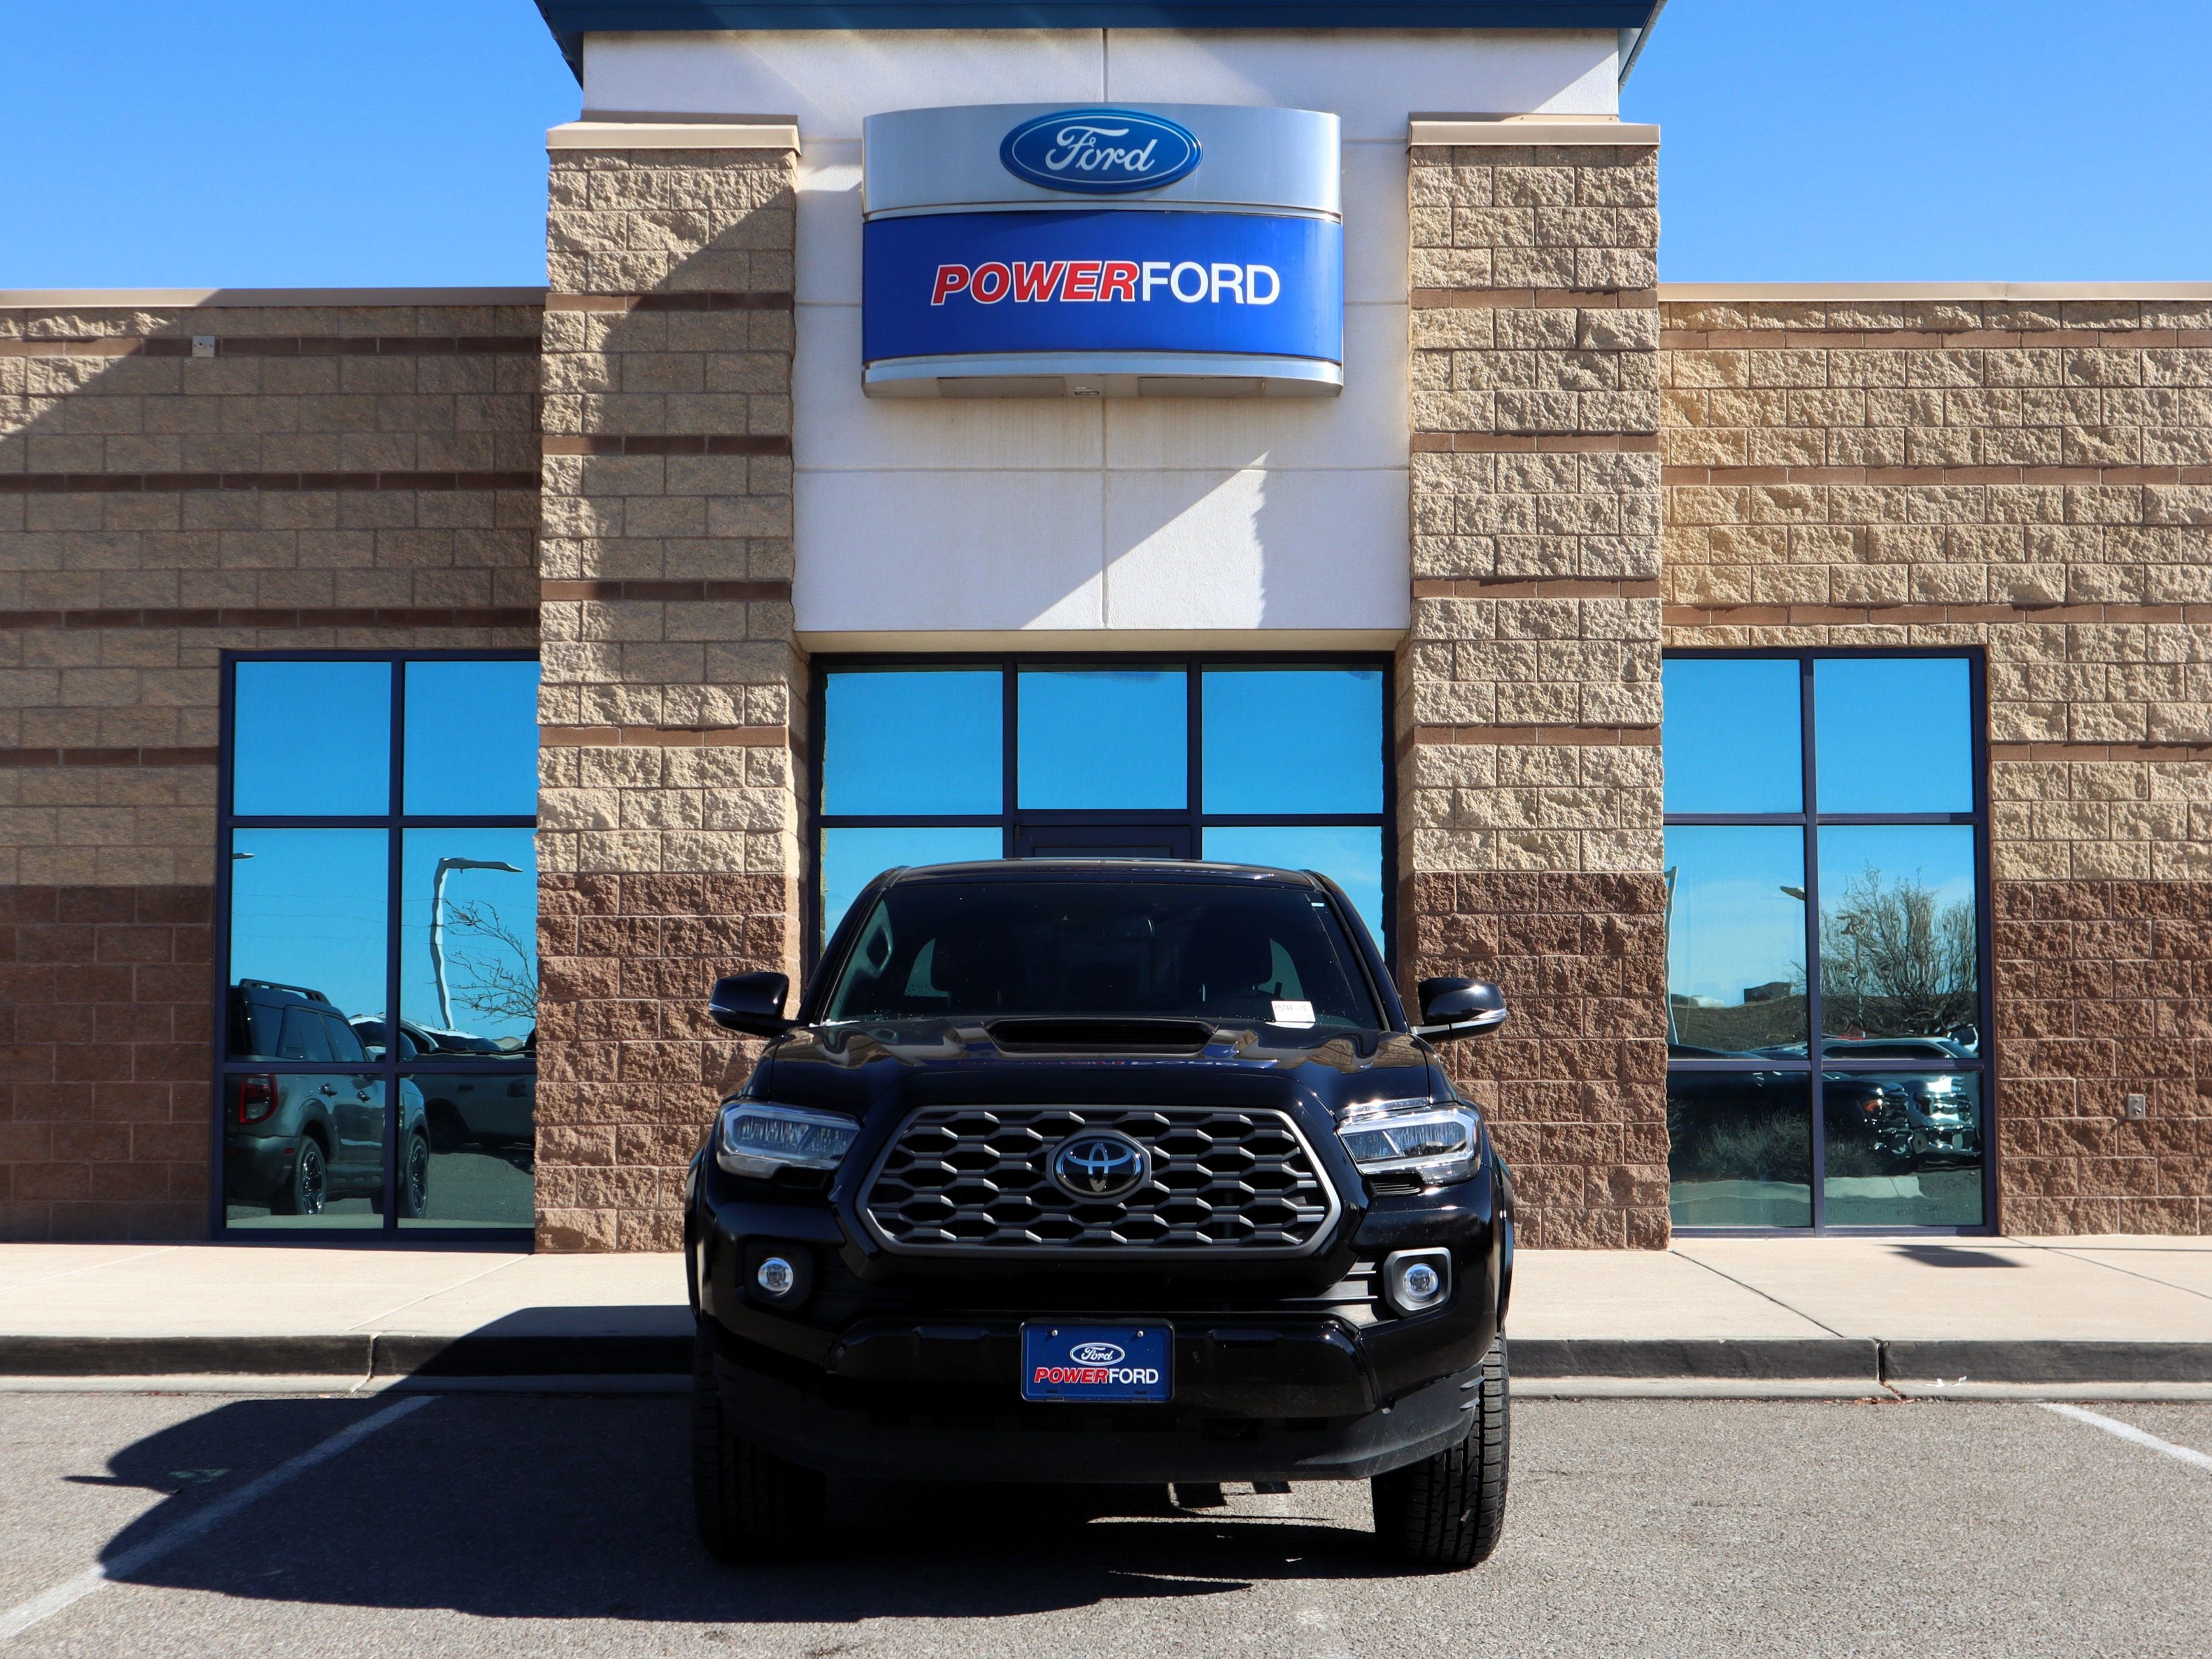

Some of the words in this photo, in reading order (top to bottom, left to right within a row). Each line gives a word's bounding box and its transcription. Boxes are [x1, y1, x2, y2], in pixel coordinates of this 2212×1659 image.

[1045, 125, 1158, 171] Ford
[931, 261, 1281, 306] POWERFORD
[1081, 1346, 1113, 1361] Ford
[1034, 1367, 1159, 1384] POWERFORD
